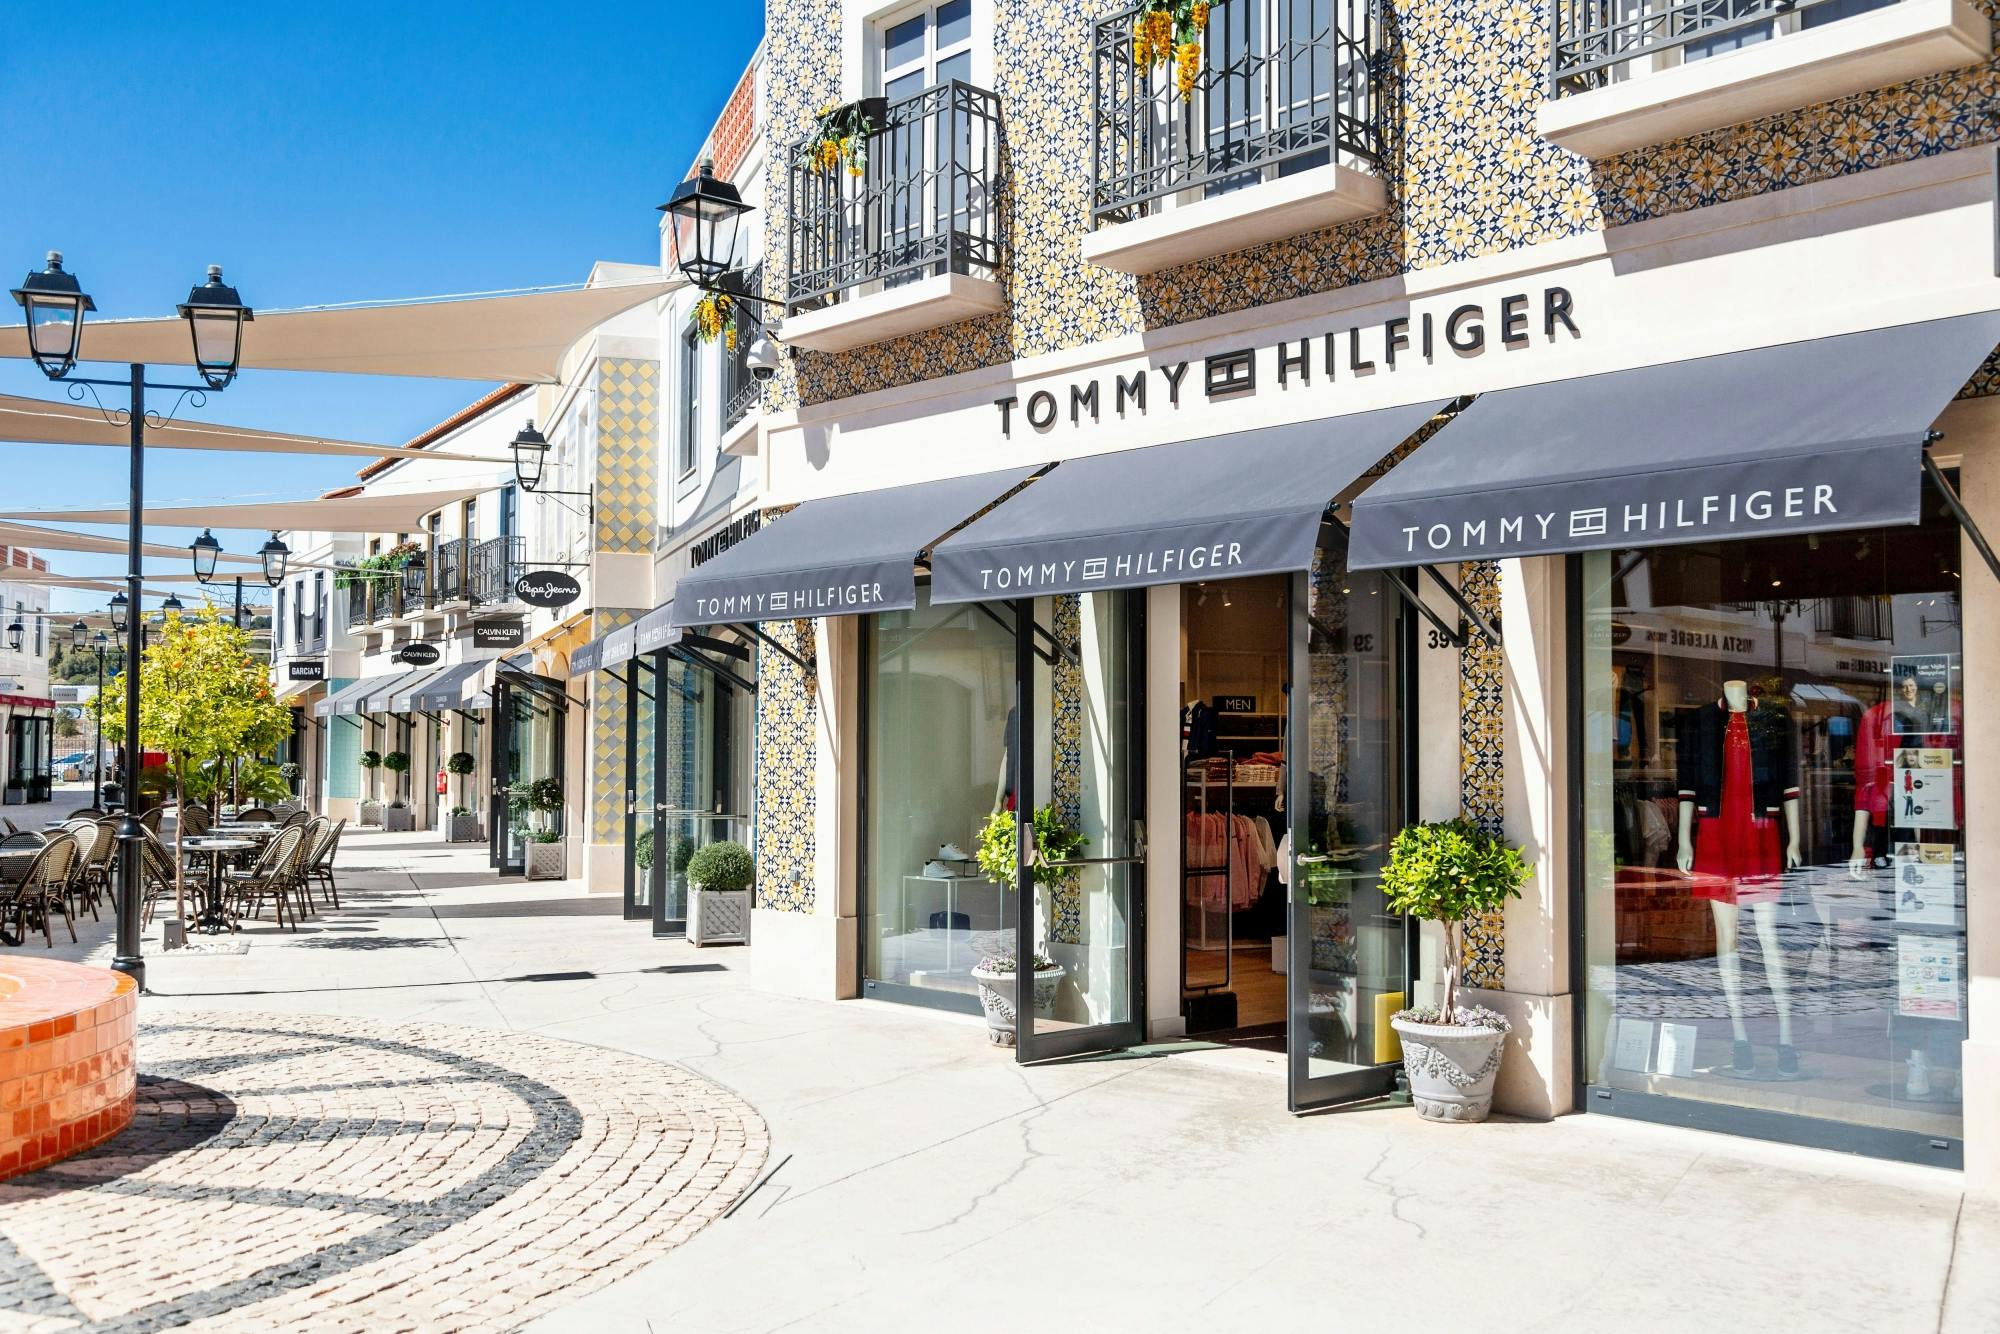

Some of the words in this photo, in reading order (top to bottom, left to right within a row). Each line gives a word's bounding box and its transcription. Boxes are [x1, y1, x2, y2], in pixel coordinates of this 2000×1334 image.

[995, 362, 1189, 435] TOMMY
[1277, 286, 1580, 385] HILFIGER
[1402, 512, 1556, 552] TOMMY
[1624, 484, 1838, 532] HILFIGER
[690, 533, 720, 568] TOMMY
[980, 560, 1077, 590] TOMMY
[1115, 542, 1242, 576] HILFIGER
[518, 580, 545, 597] Pepe
[544, 582, 578, 598] Jeans
[697, 593, 766, 616] TOMMY
[794, 583, 884, 608] HILFIGER
[477, 628, 501, 636] CALVIN
[502, 628, 521, 636] KLEIN
[1428, 630, 1450, 649] 39
[1225, 699, 1251, 710] MEN
